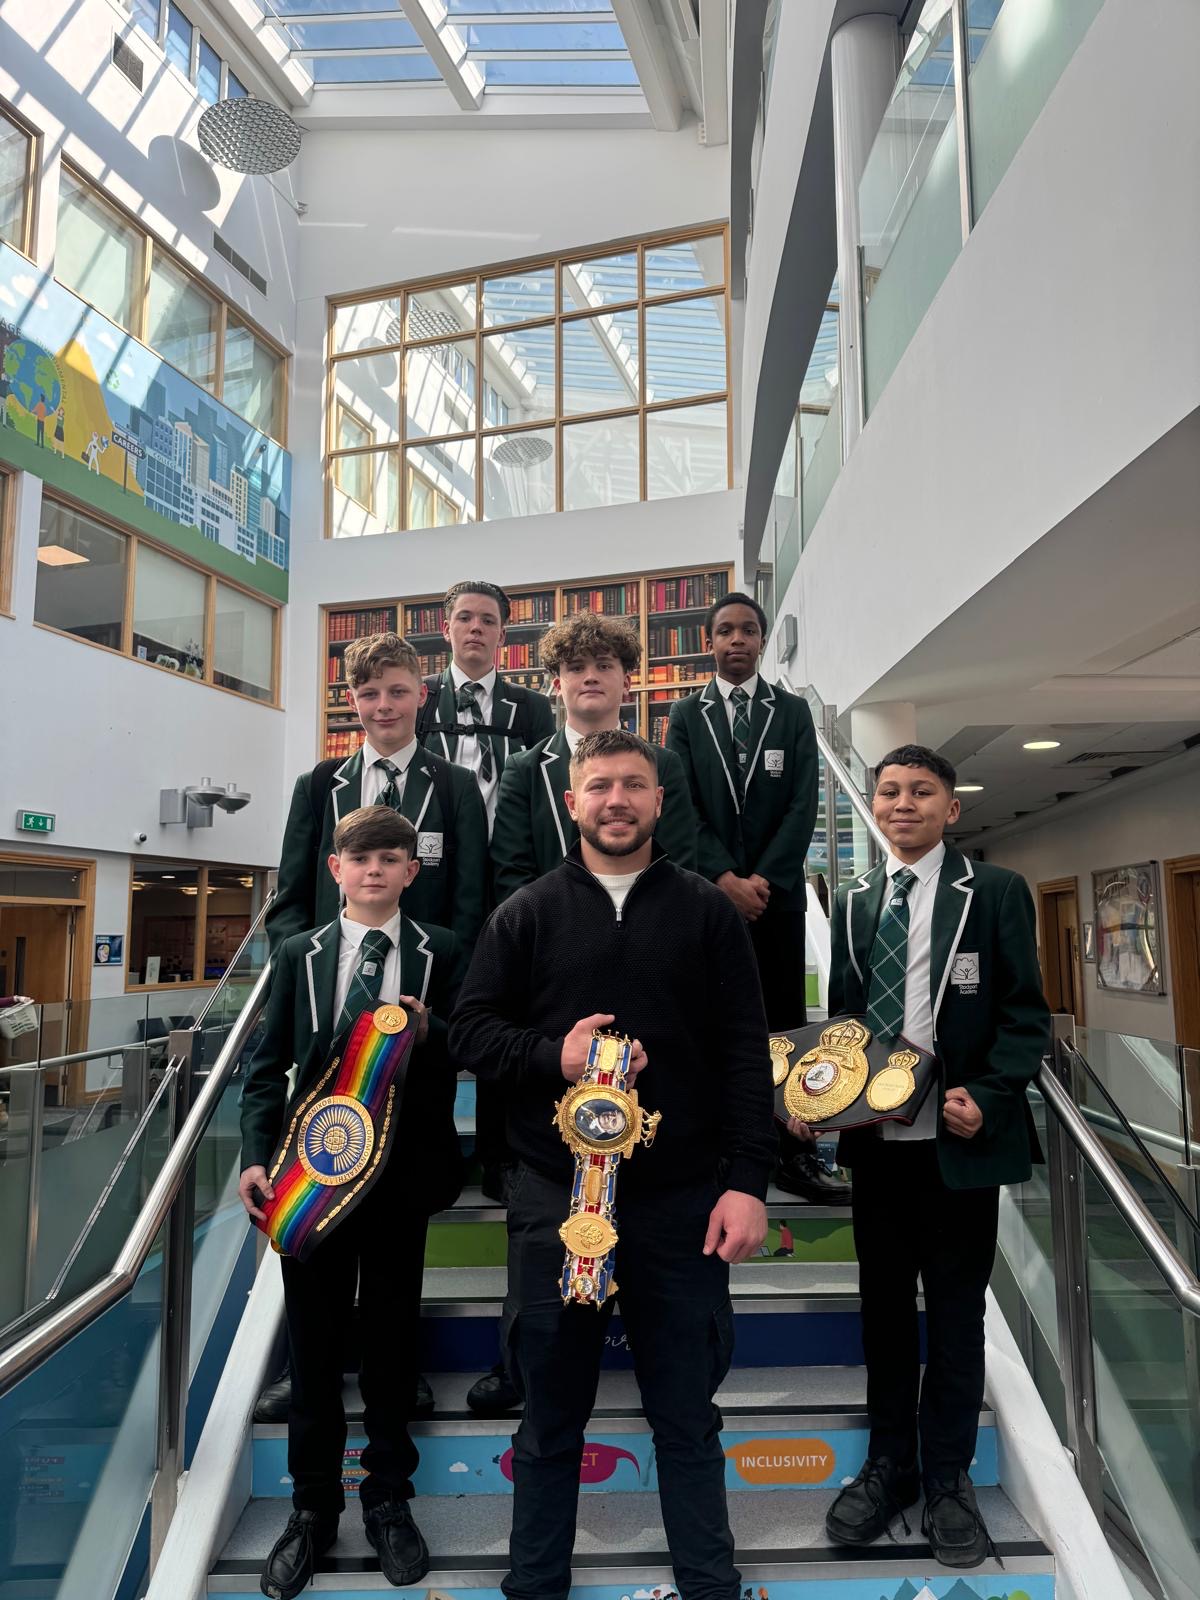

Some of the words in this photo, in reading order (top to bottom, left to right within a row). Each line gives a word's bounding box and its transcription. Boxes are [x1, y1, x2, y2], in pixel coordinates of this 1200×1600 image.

[113, 433, 143, 457] CAREERS
[308, 1098, 332, 1118] BOXING
[338, 1124, 372, 1183] COMMONWEALTH
[741, 1455, 828, 1467] INCLUSIVITY
